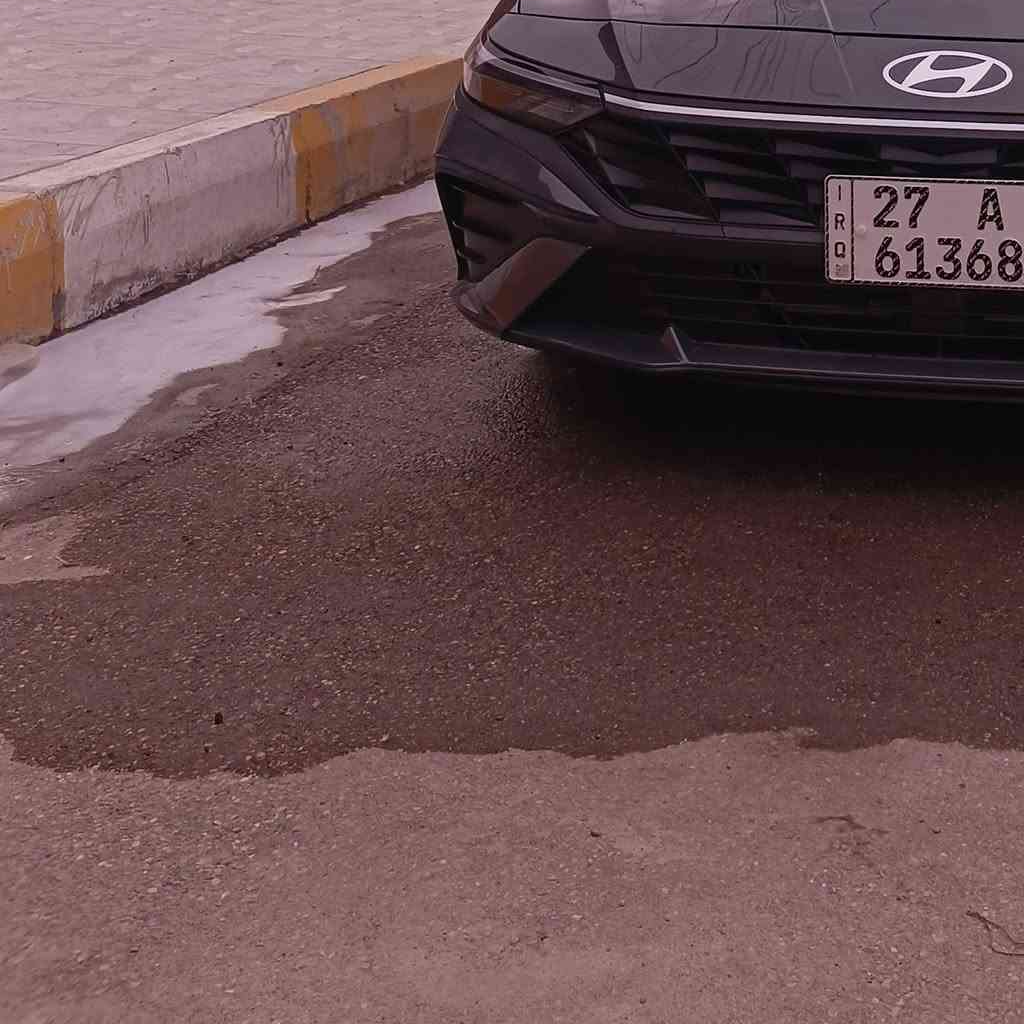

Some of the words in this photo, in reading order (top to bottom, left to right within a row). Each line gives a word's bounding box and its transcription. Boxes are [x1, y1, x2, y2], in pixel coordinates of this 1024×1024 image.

[873, 185, 930, 229] 27
[976, 188, 1005, 231] A
[874, 236, 1024, 282] 61368
